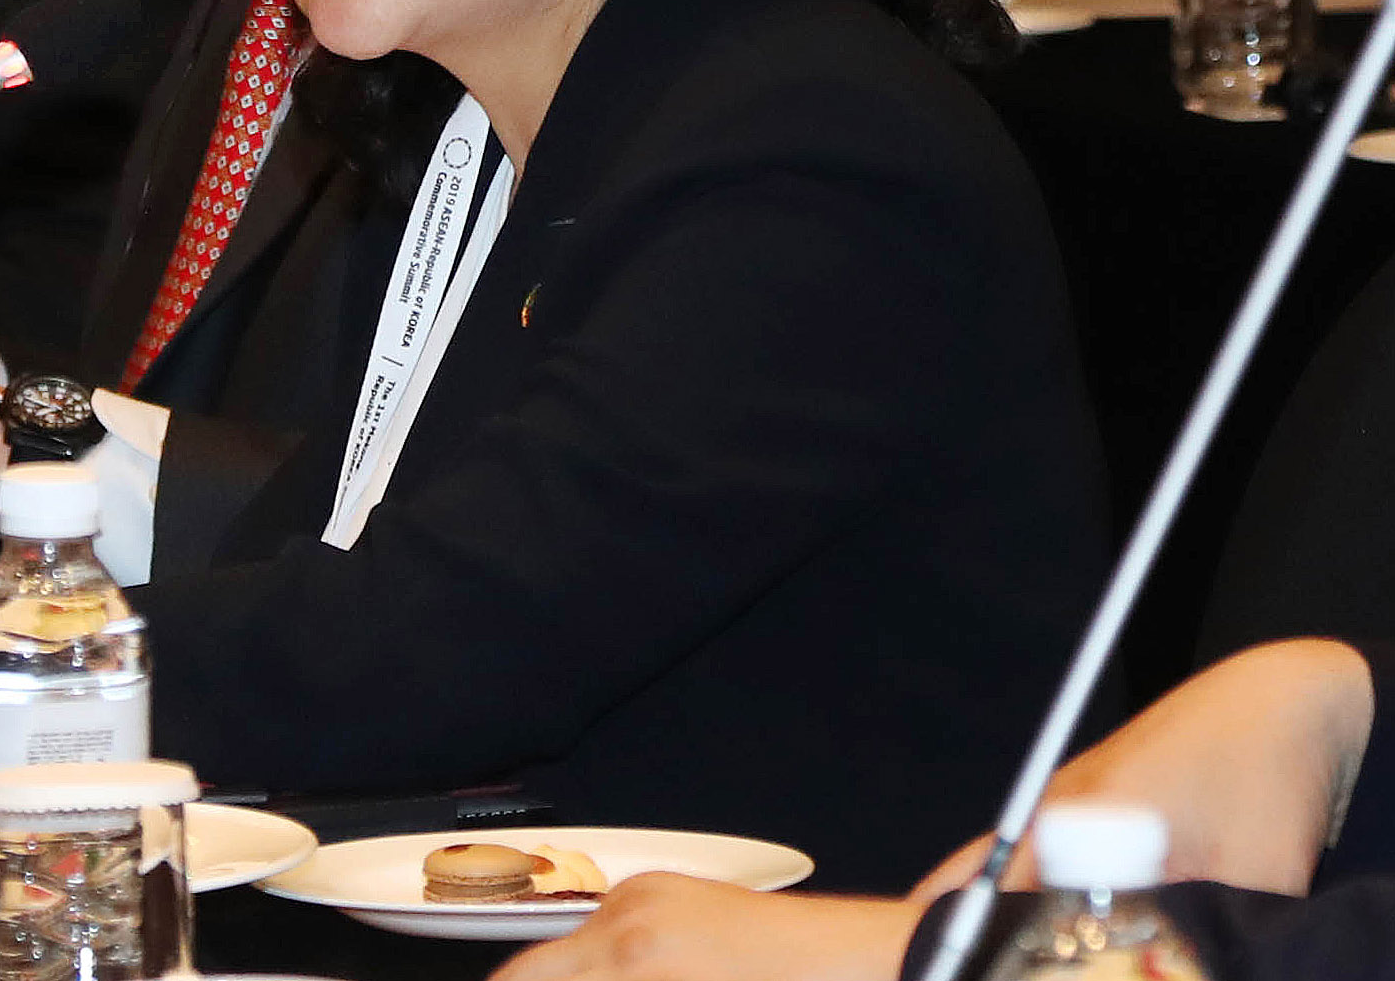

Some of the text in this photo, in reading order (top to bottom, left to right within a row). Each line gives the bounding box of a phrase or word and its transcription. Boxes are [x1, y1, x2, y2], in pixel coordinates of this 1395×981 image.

[398, 172, 447, 304] Commemorative Summit
[401, 176, 462, 348] 2019 ASEAN-Republic of KOREA
[363, 374, 384, 424] Republic
[382, 381, 395, 401] The
[374, 403, 385, 423] 1st
[357, 427, 365, 442] of
